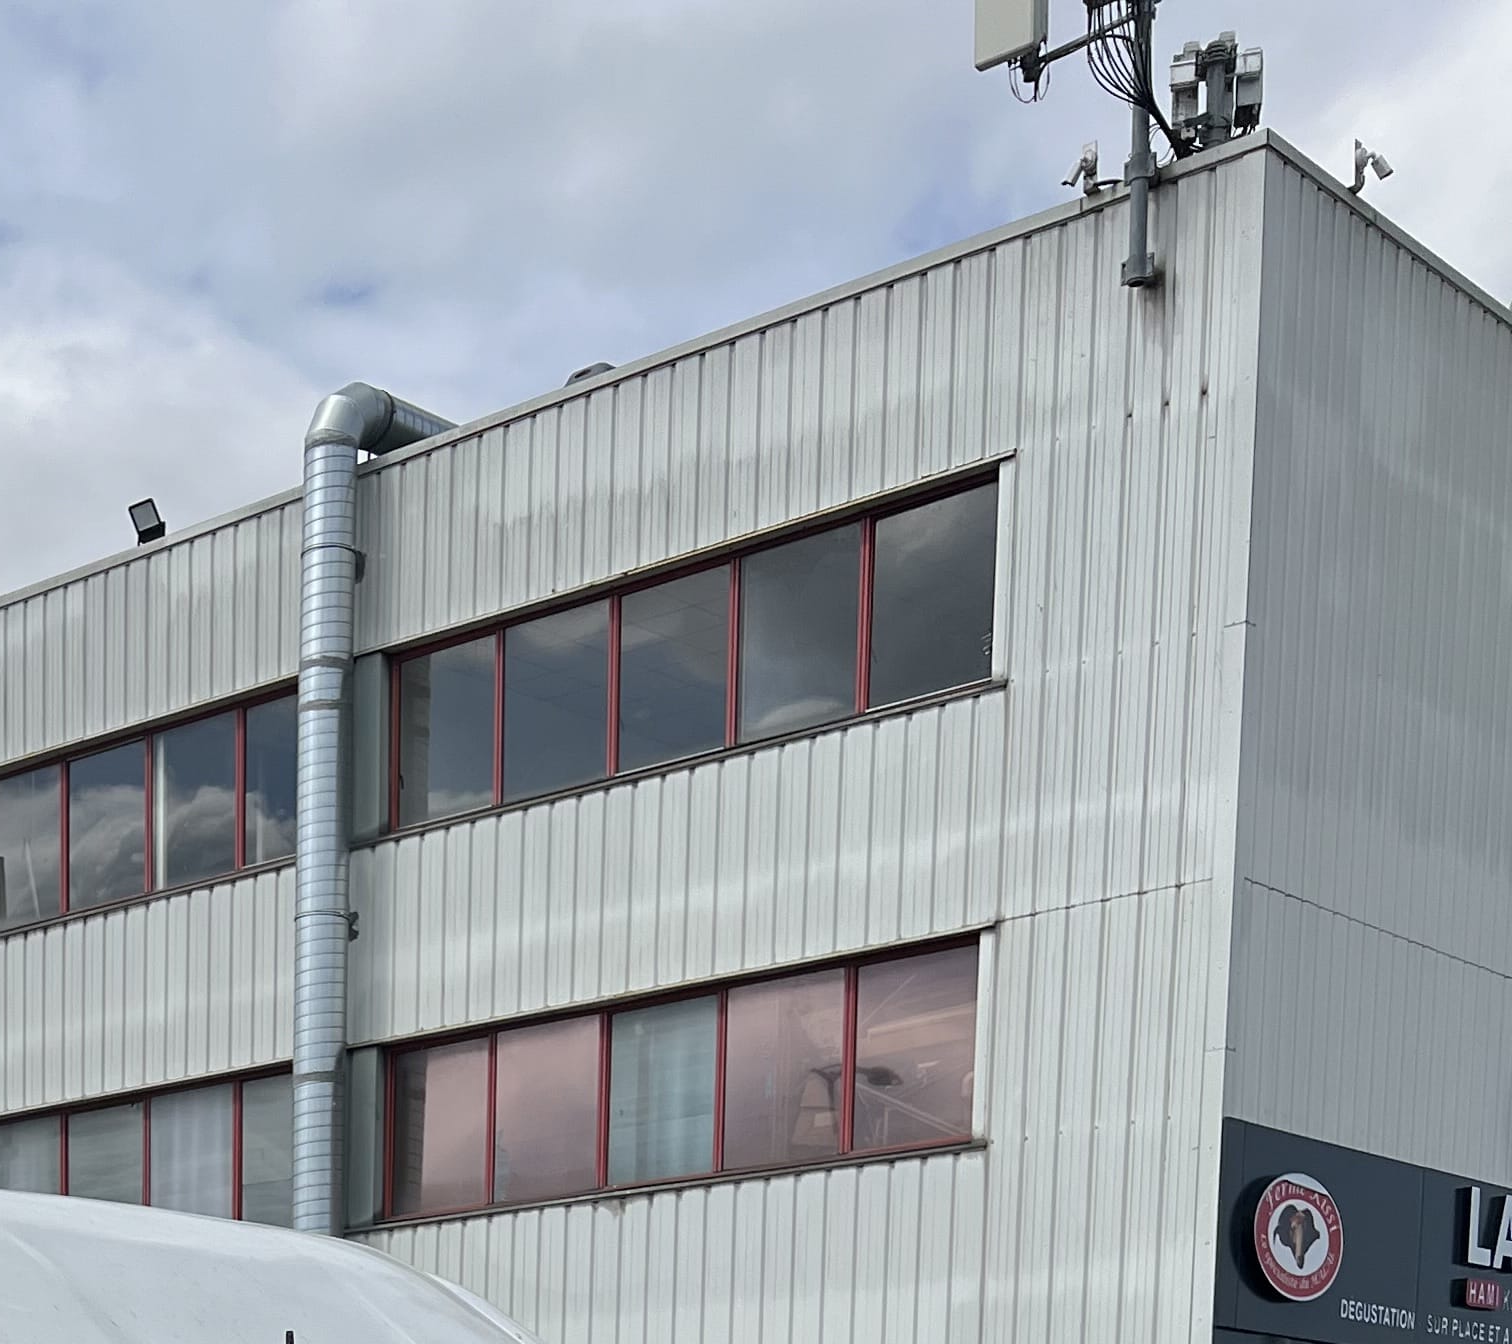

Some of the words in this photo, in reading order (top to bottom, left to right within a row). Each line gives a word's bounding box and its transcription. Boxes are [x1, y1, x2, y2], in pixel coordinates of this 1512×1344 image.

[1469, 1281, 1500, 1307] HAMI
[1427, 1314, 1448, 1336] SUR
[1451, 1318, 1485, 1341] PLACE
[1488, 1324, 1501, 1343] ET
